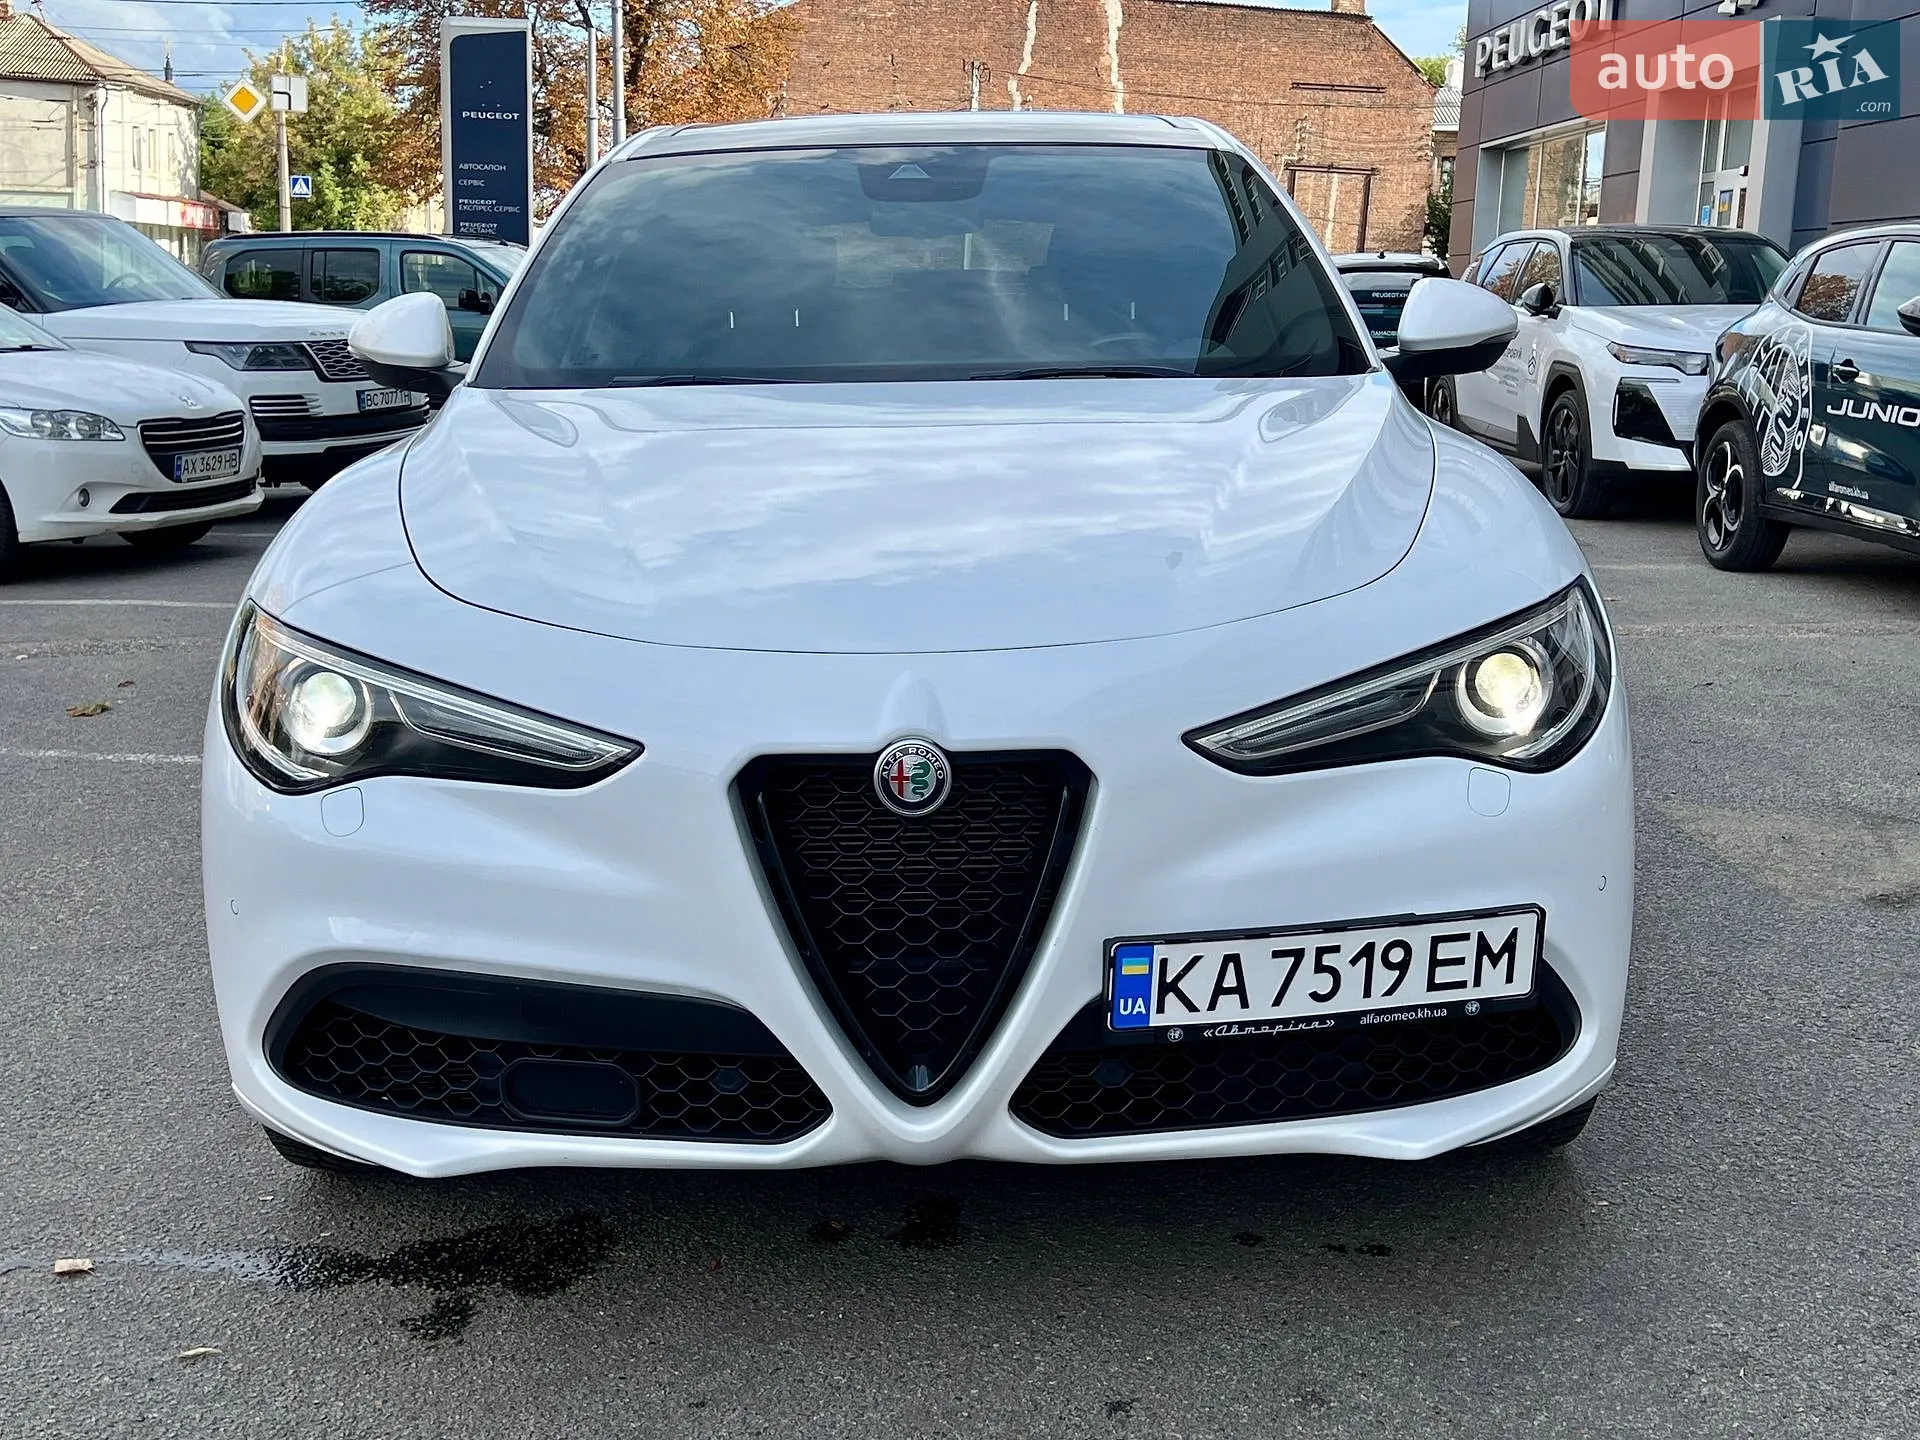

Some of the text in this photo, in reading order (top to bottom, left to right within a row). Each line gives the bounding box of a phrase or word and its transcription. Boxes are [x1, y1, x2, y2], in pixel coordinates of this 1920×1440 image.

[462, 111, 520, 120] PEUGEOT
[458, 163, 507, 171] АВТОСАЛОН
[458, 179, 485, 187] СЕРВІС
[366, 393, 379, 407] BC
[1826, 398, 1920, 427] JUNIO
[183, 457, 198, 475] AX
[199, 454, 223, 473] 3629
[224, 452, 238, 470] HB
[882, 747, 945, 779] ALFA ROMEO
[1156, 927, 1519, 1015] KA 7519 EM
[1119, 997, 1147, 1015] UA
[1360, 1008, 1447, 1025] alfaromeo.kh.ua
